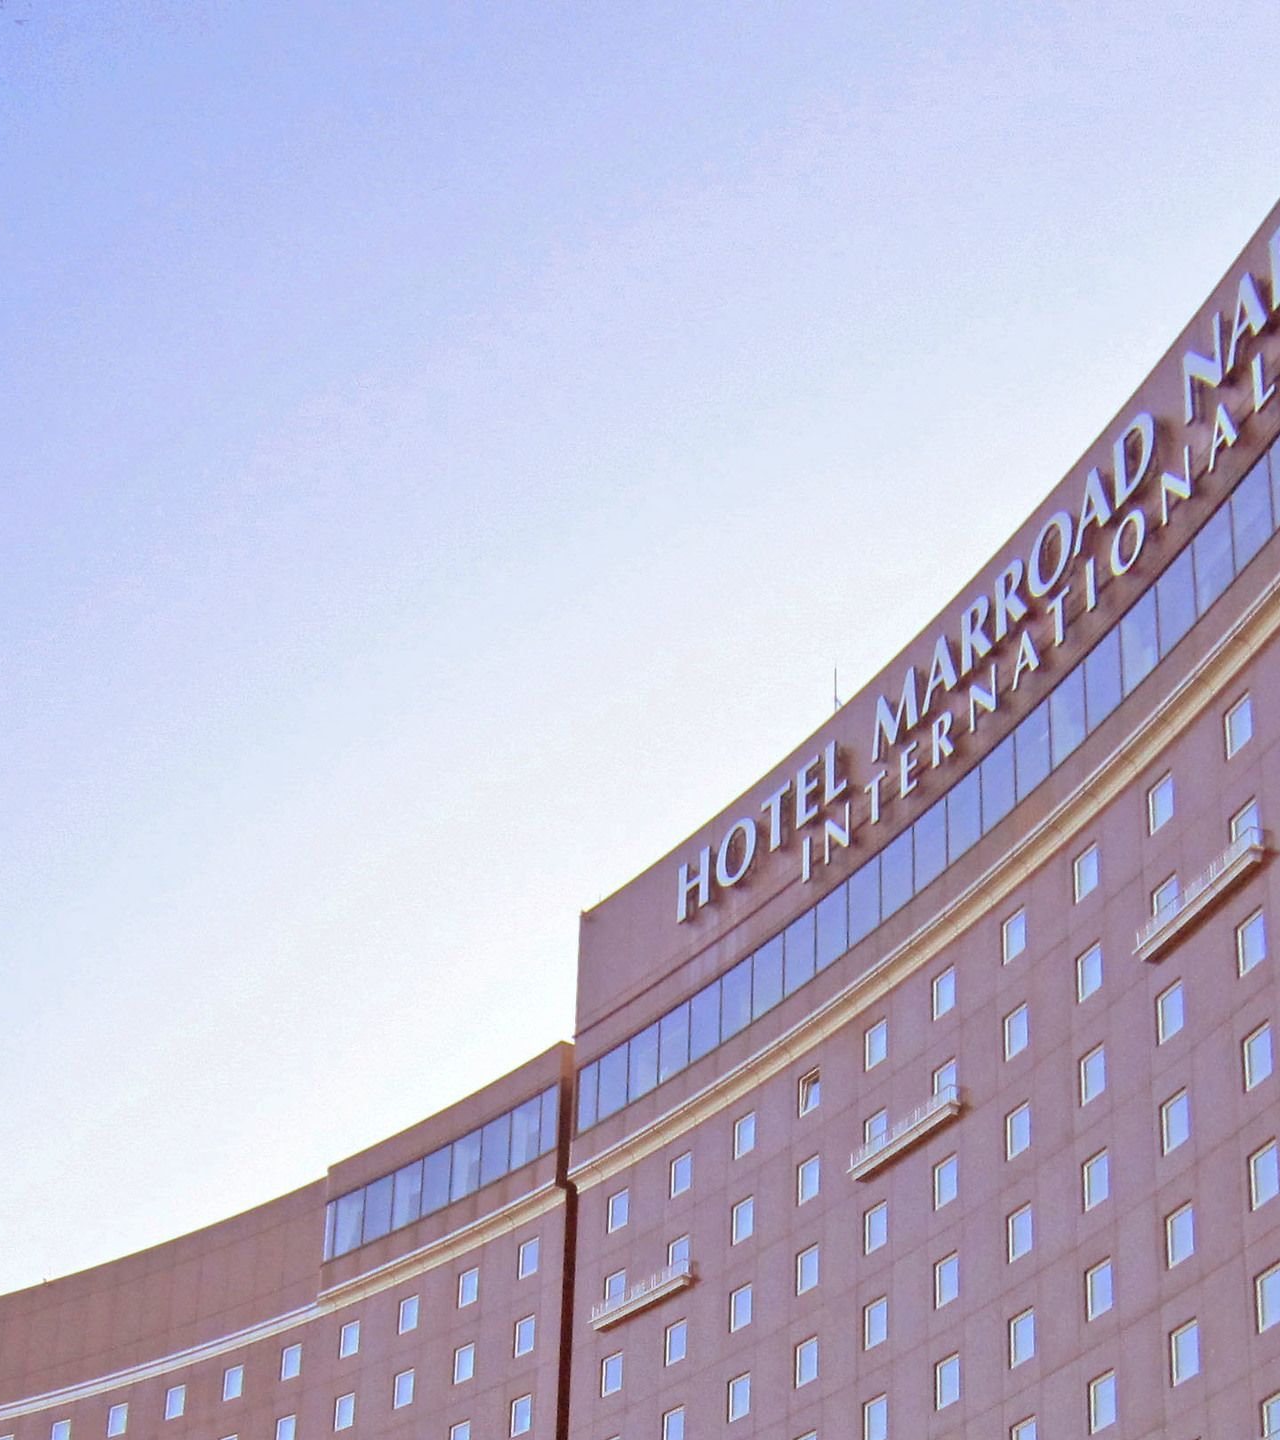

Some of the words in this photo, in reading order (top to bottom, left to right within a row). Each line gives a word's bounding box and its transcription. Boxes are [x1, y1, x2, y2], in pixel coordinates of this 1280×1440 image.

[676, 740, 848, 924] HOTEL
[872, 411, 1156, 762] MARROAD
[801, 352, 1277, 884] INTERNATIONAL
